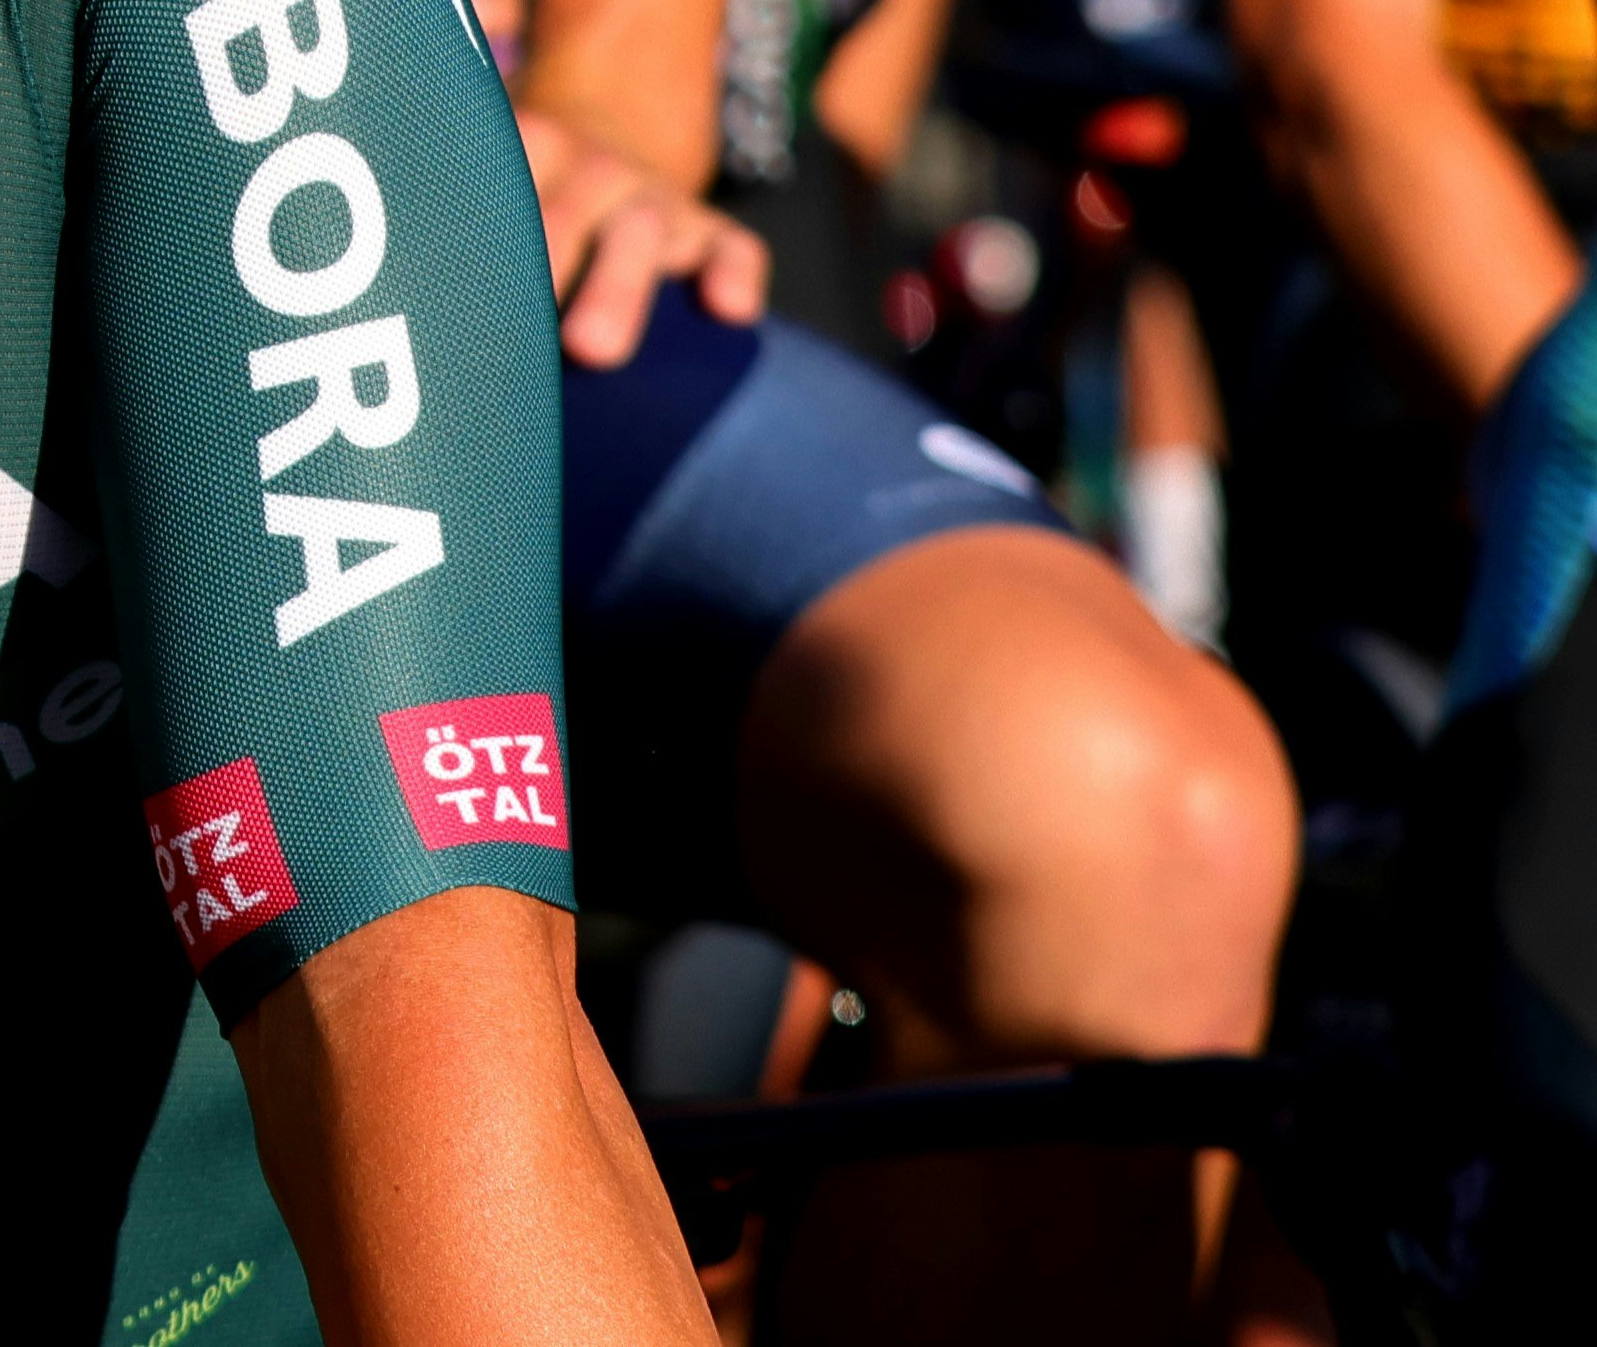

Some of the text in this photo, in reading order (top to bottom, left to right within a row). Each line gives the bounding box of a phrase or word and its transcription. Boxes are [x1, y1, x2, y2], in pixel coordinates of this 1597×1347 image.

[422, 724, 551, 781] ÖTZ
[436, 785, 557, 827] TAL
[150, 810, 250, 894] ÖTZ
[172, 872, 269, 947] TAL
